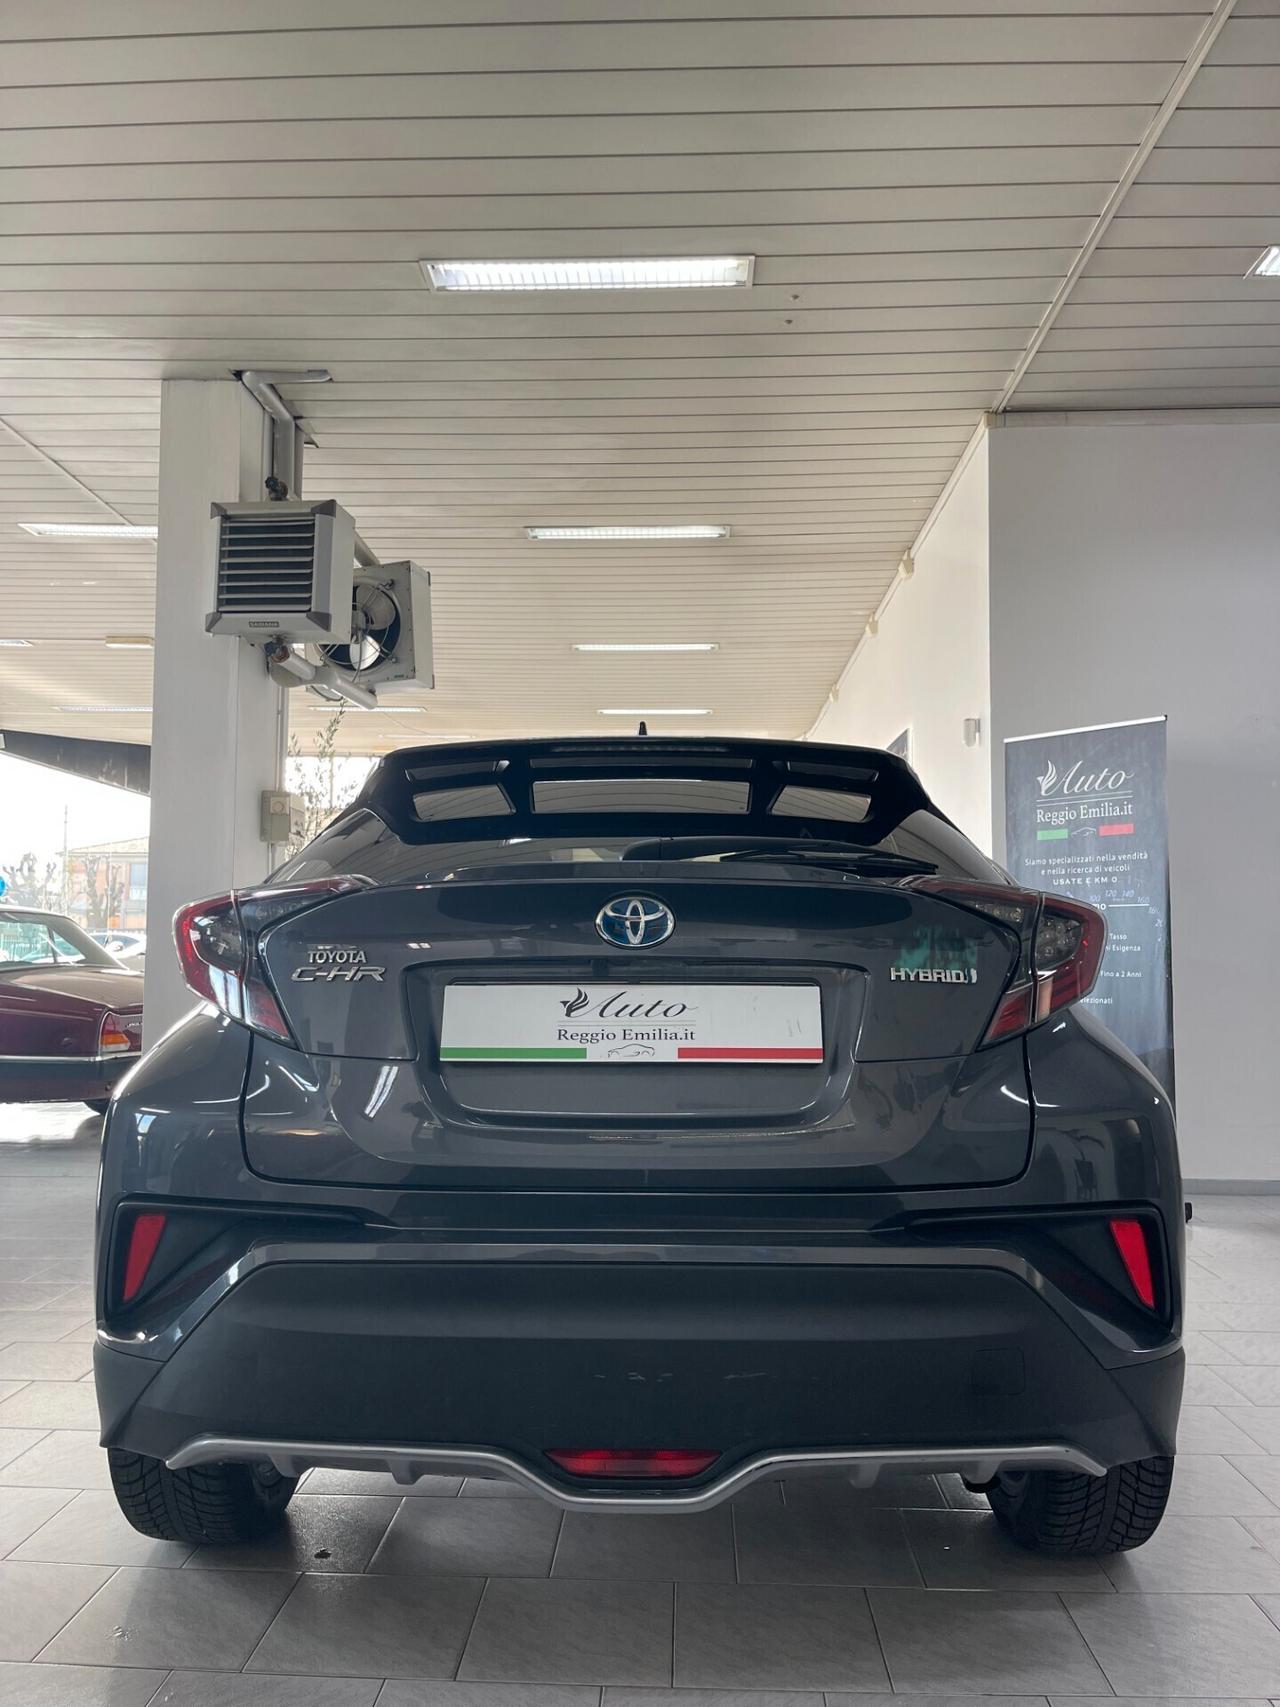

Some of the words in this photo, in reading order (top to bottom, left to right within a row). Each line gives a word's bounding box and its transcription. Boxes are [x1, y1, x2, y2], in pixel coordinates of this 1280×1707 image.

[1041, 760, 1135, 796] Auto
[1036, 806, 1077, 825] Reggio
[1080, 801, 1133, 819] Emilia.it
[1025, 857, 1047, 866] Siamo
[1048, 855, 1095, 866] specializzati
[1096, 853, 1116, 862] nella
[1047, 867, 1066, 875] nella
[1067, 865, 1093, 874] ricerca
[1094, 864, 1102, 873] di
[1104, 863, 1130, 872] veicoli
[1053, 877, 1082, 886] USATE
[1094, 876, 1108, 884] KM
[1109, 932, 1127, 940] Tasso
[1112, 944, 1141, 953] Esigenza
[308, 951, 367, 963] TOYOTA
[291, 966, 386, 981] C-HR
[890, 968, 965, 983] HYBRID
[565, 990, 698, 1018] Auto
[557, 1028, 616, 1044] Reggio
[622, 1028, 696, 1041] Emilia.it
